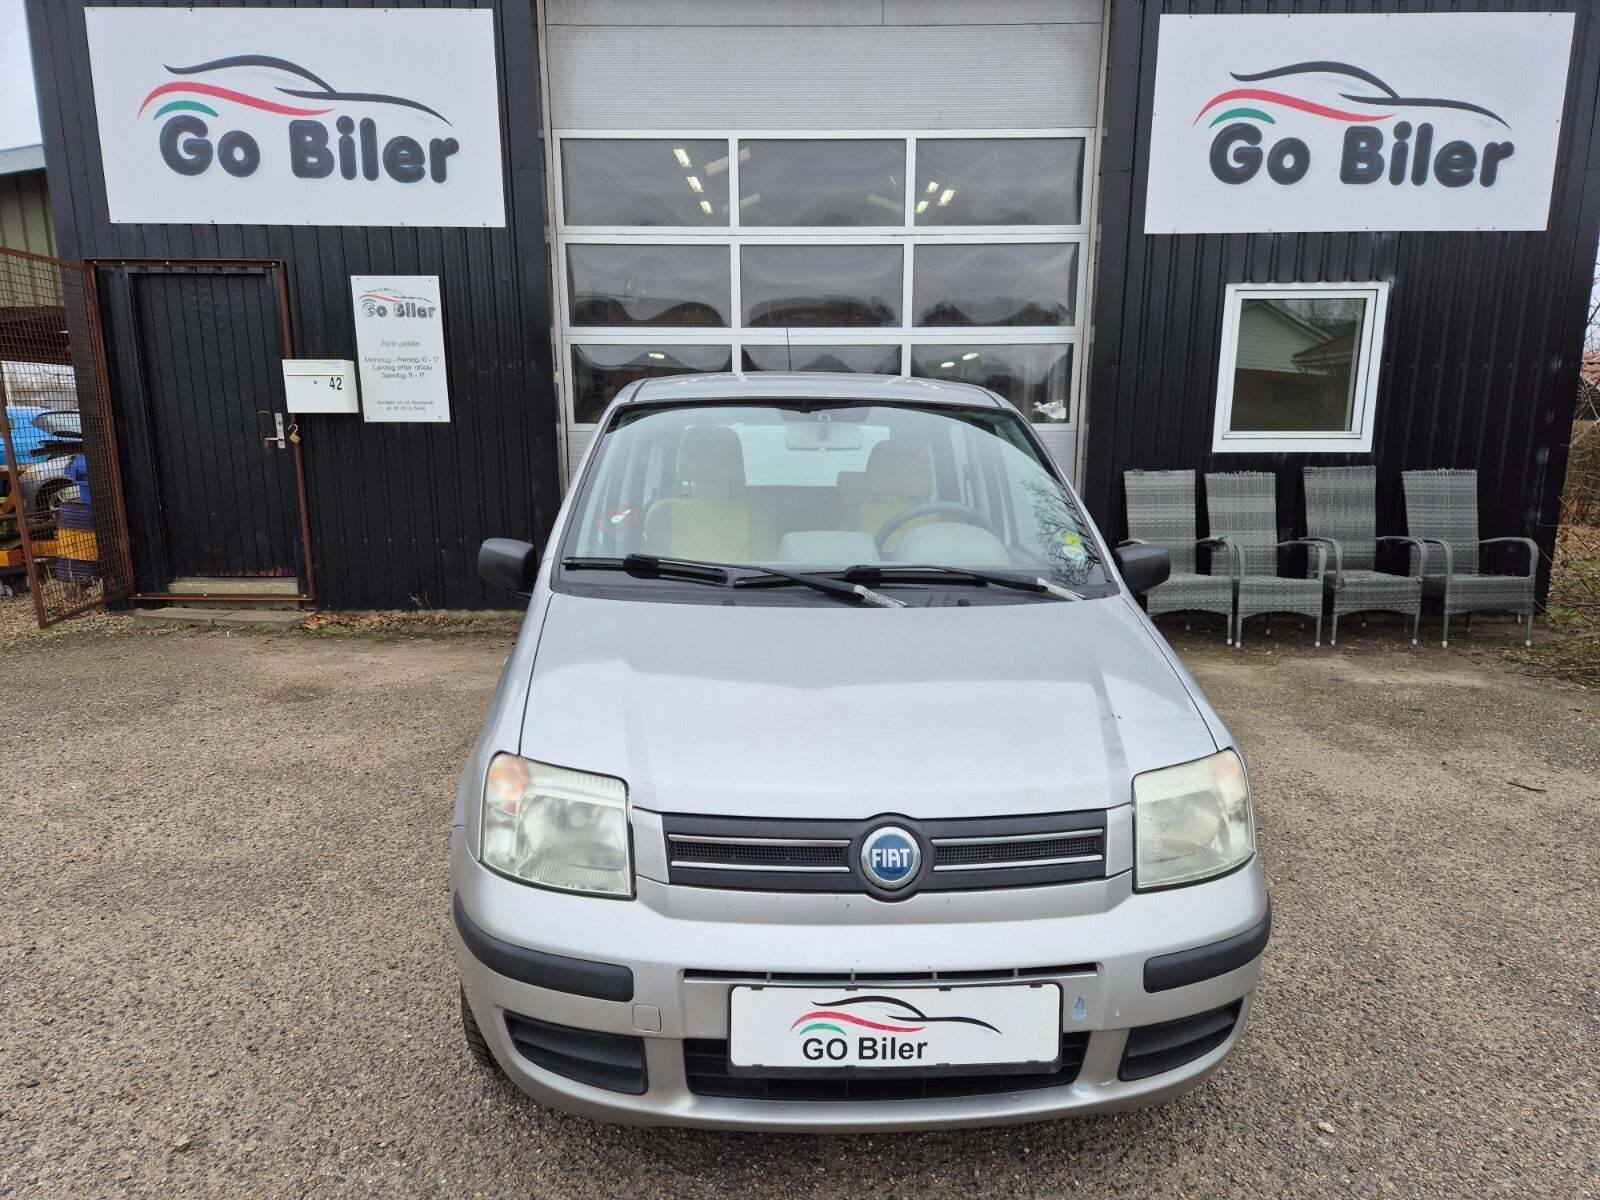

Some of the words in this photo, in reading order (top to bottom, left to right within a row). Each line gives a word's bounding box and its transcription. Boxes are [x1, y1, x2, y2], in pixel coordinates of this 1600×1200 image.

[159, 114, 261, 178] Go
[289, 115, 460, 184] Biler
[1209, 121, 1311, 186] Go
[1339, 121, 1515, 188] Biler
[362, 302, 388, 318] Go
[394, 302, 436, 318] Biler
[329, 376, 343, 390] 42
[871, 848, 911, 868] FIAT
[802, 1037, 848, 1061] GO
[858, 1036, 928, 1060] Biler
